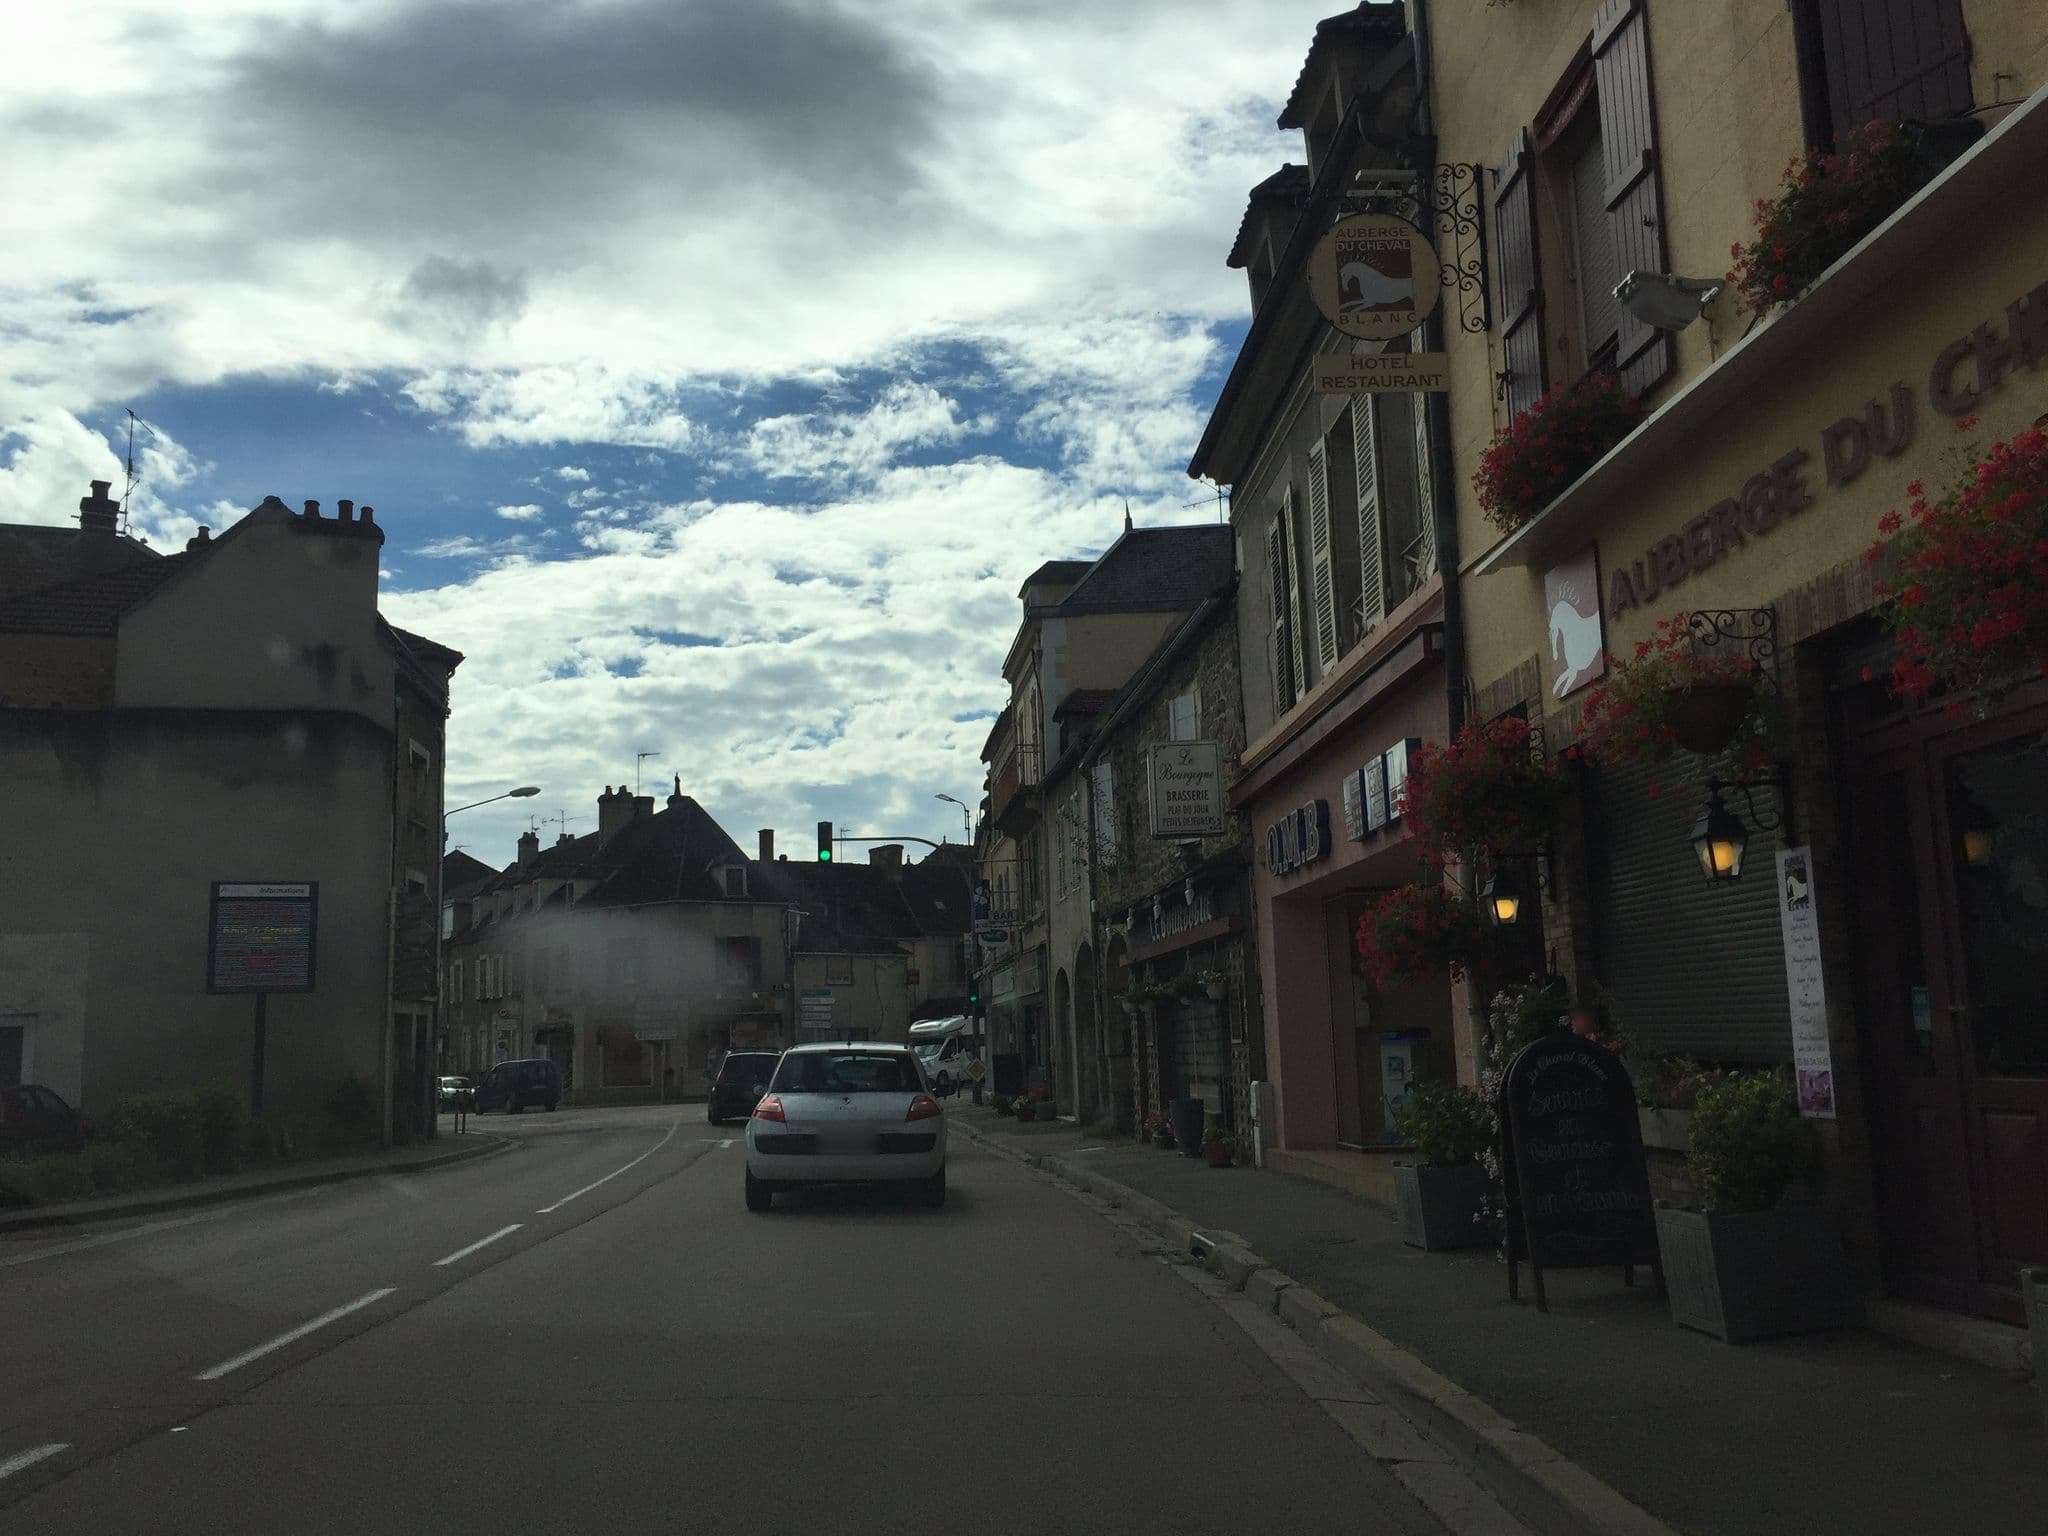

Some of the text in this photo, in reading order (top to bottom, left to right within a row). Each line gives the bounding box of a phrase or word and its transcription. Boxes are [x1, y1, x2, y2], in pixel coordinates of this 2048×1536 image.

[1335, 226, 1409, 239] AUBERGE
[1336, 239, 1411, 251] DU CHEVAL
[1339, 312, 1417, 326] BLANC
[1350, 356, 1415, 370] HOTEL
[1321, 373, 1443, 389] RESTAURANT
[1607, 447, 1811, 622] AUBERGE
[1821, 378, 1914, 489] DU
[1158, 763, 1215, 786] Bourgogne
[1166, 790, 1210, 802] BRASSERIE
[993, 911, 1014, 920] BAR
